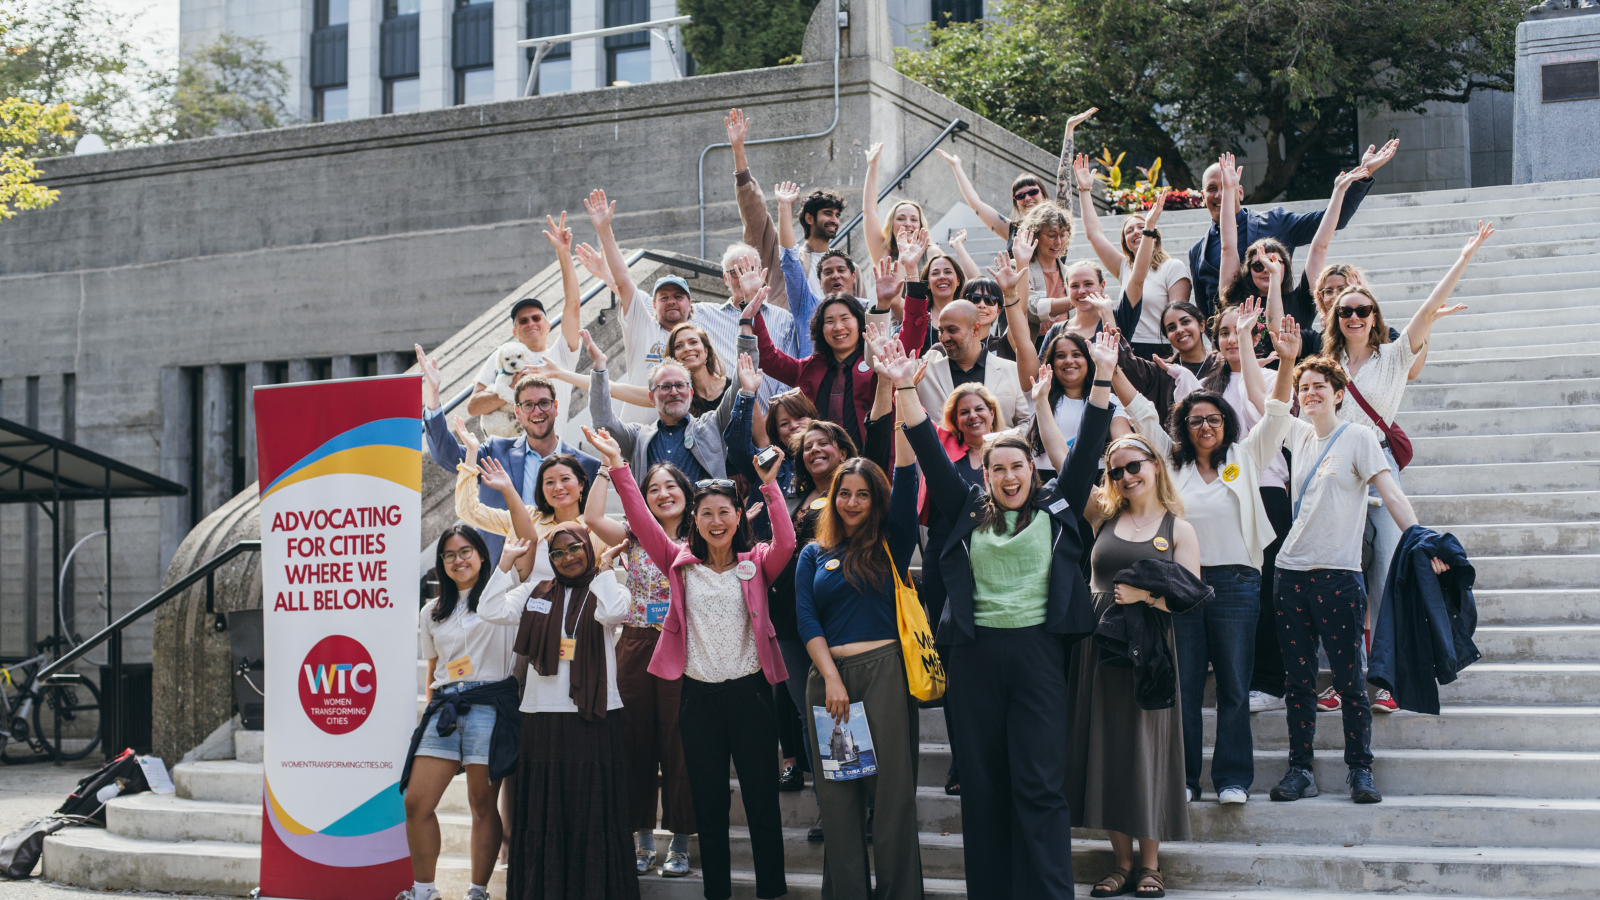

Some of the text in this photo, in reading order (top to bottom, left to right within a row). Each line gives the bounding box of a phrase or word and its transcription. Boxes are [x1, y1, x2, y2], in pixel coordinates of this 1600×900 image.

[271, 505, 402, 532] ADVOCATING
[287, 533, 386, 558] FOR CITIES
[284, 560, 387, 585] WHERE WE
[273, 587, 394, 612] ALL BELONG.
[303, 662, 373, 694] WTC
[311, 707, 367, 715] TRANSFORMING
[323, 698, 352, 706] WOMEN
[326, 717, 349, 725] CITIES
[280, 760, 393, 769] WOMENTRANSFORMINGCITIES.ORG
